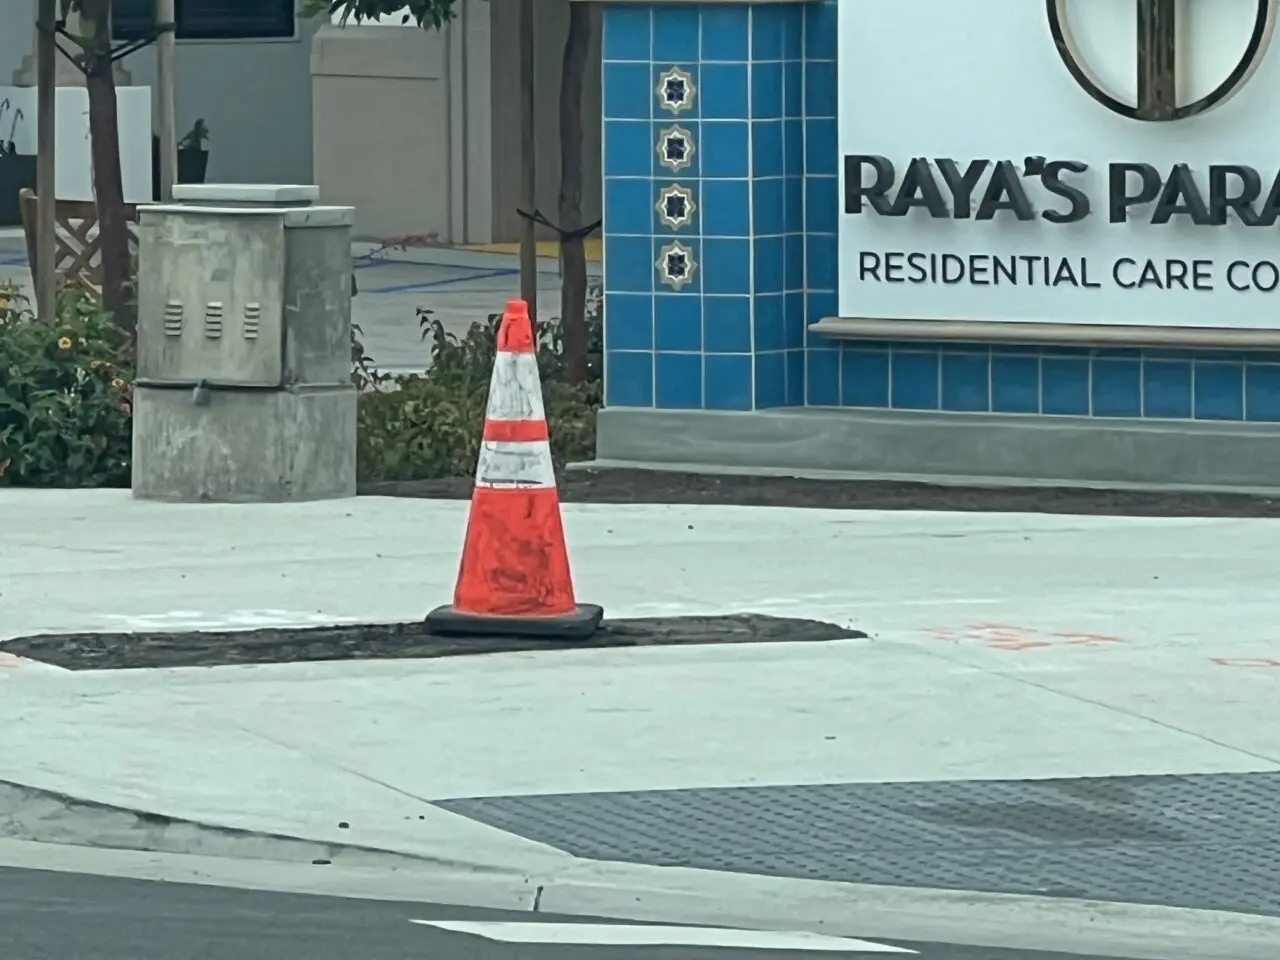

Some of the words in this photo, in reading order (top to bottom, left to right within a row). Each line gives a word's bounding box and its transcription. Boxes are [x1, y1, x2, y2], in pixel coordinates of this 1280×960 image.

[843, 153, 1091, 225] RAYA'S
[858, 250, 1101, 289] RESIDENTIAL
[1112, 257, 1214, 291] CARE
